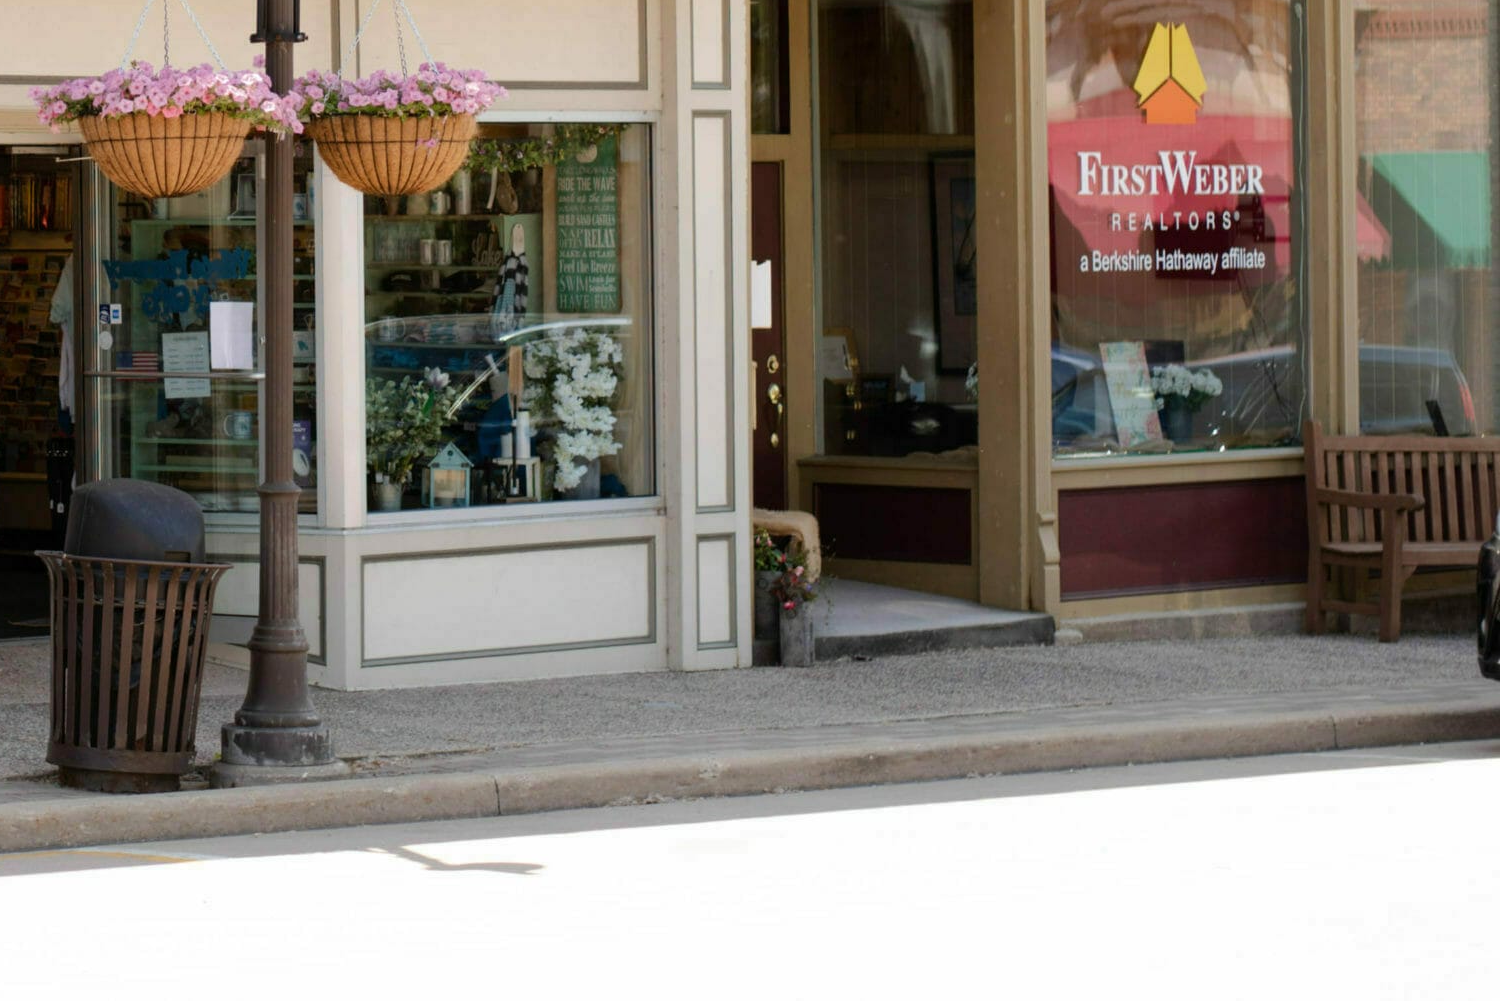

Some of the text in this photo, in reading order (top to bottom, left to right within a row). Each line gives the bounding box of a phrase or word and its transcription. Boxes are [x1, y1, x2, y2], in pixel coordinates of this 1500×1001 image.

[558, 176, 616, 191] RIDE THE WAVE
[577, 214, 591, 226] SAND
[592, 214, 616, 226] CASTLES
[584, 228, 616, 248] RELAX
[559, 259, 575, 273] Feel
[590, 259, 616, 274] Breeze
[1080, 246, 1266, 275] a Berkshire Hathaway affiliate
[560, 275, 588, 292] SWIM
[560, 293, 616, 310] HAVE FUN
